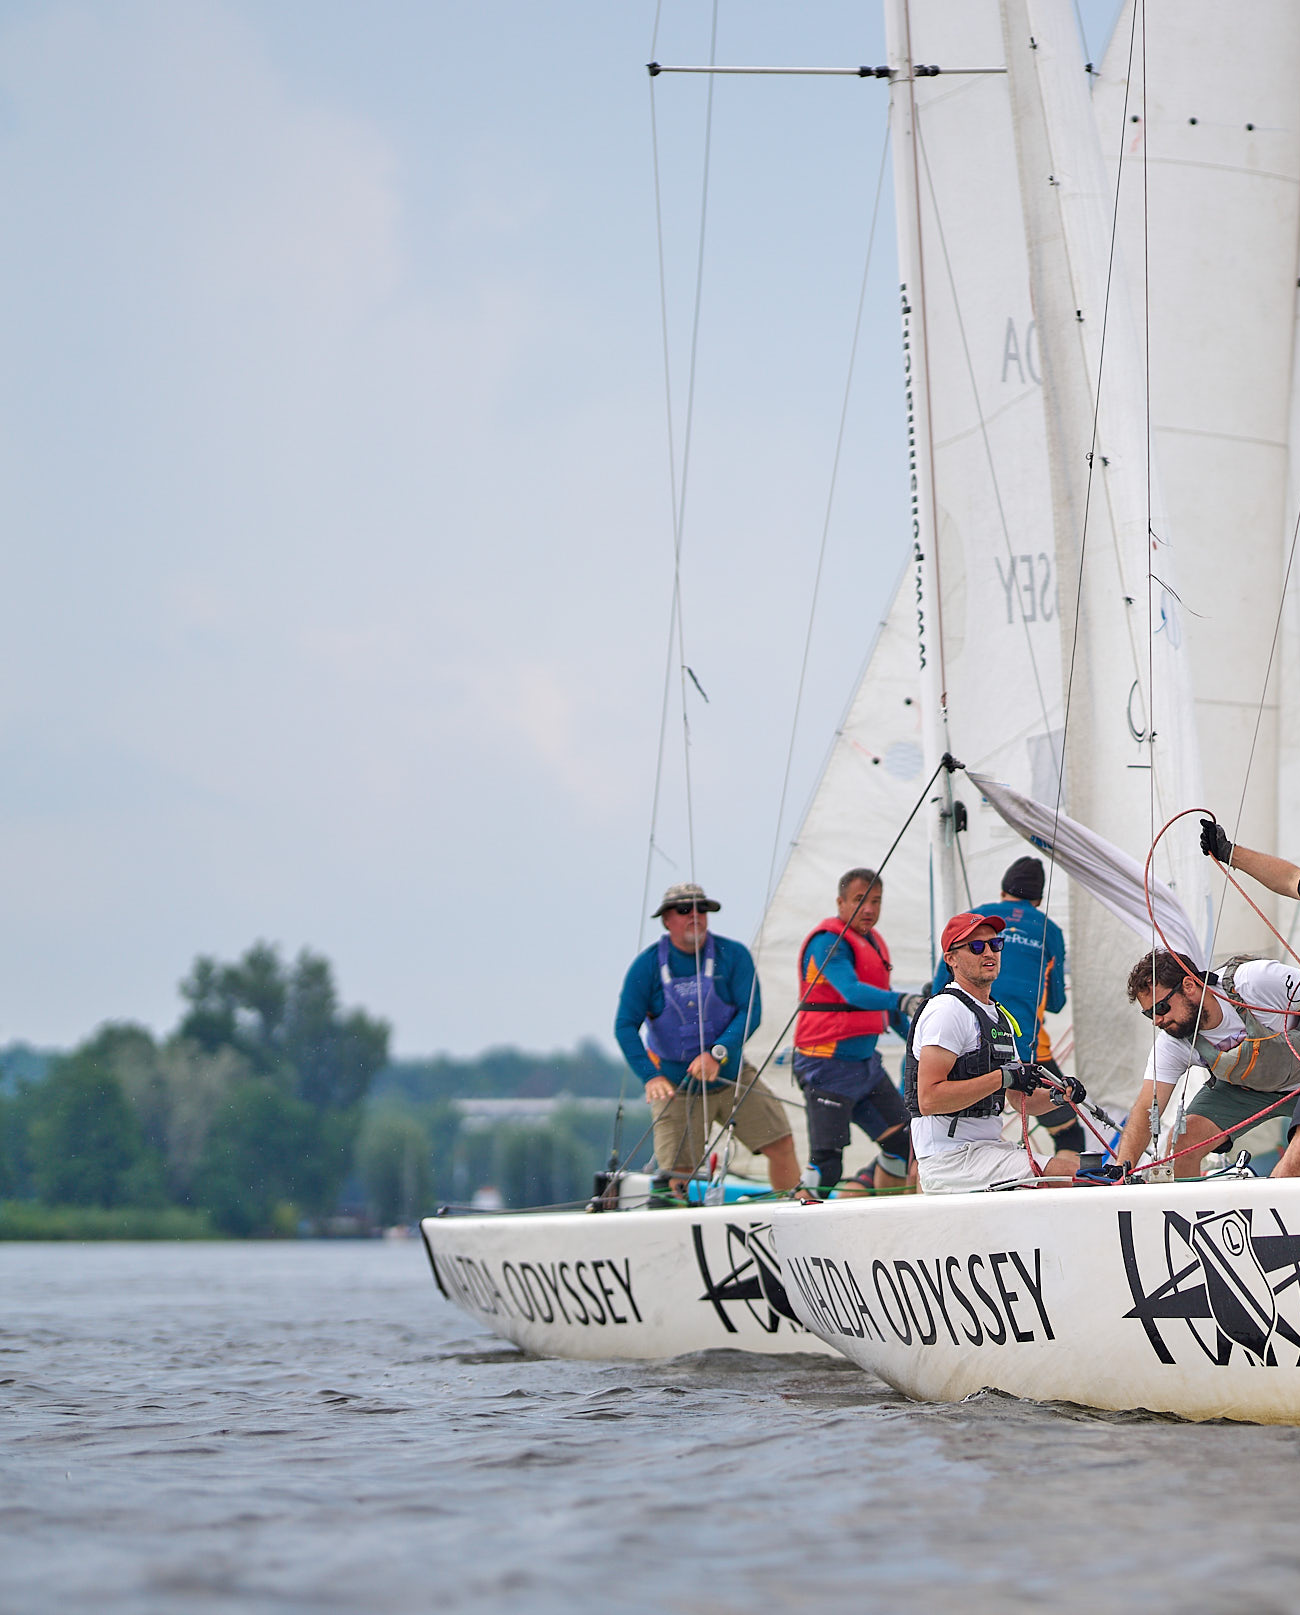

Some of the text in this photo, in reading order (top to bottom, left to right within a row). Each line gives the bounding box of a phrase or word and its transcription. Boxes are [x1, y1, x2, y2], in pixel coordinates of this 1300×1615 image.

[502, 1256, 643, 1326] ODYSSEY
[787, 1248, 1056, 1347] MAZDA ODYSSEY
